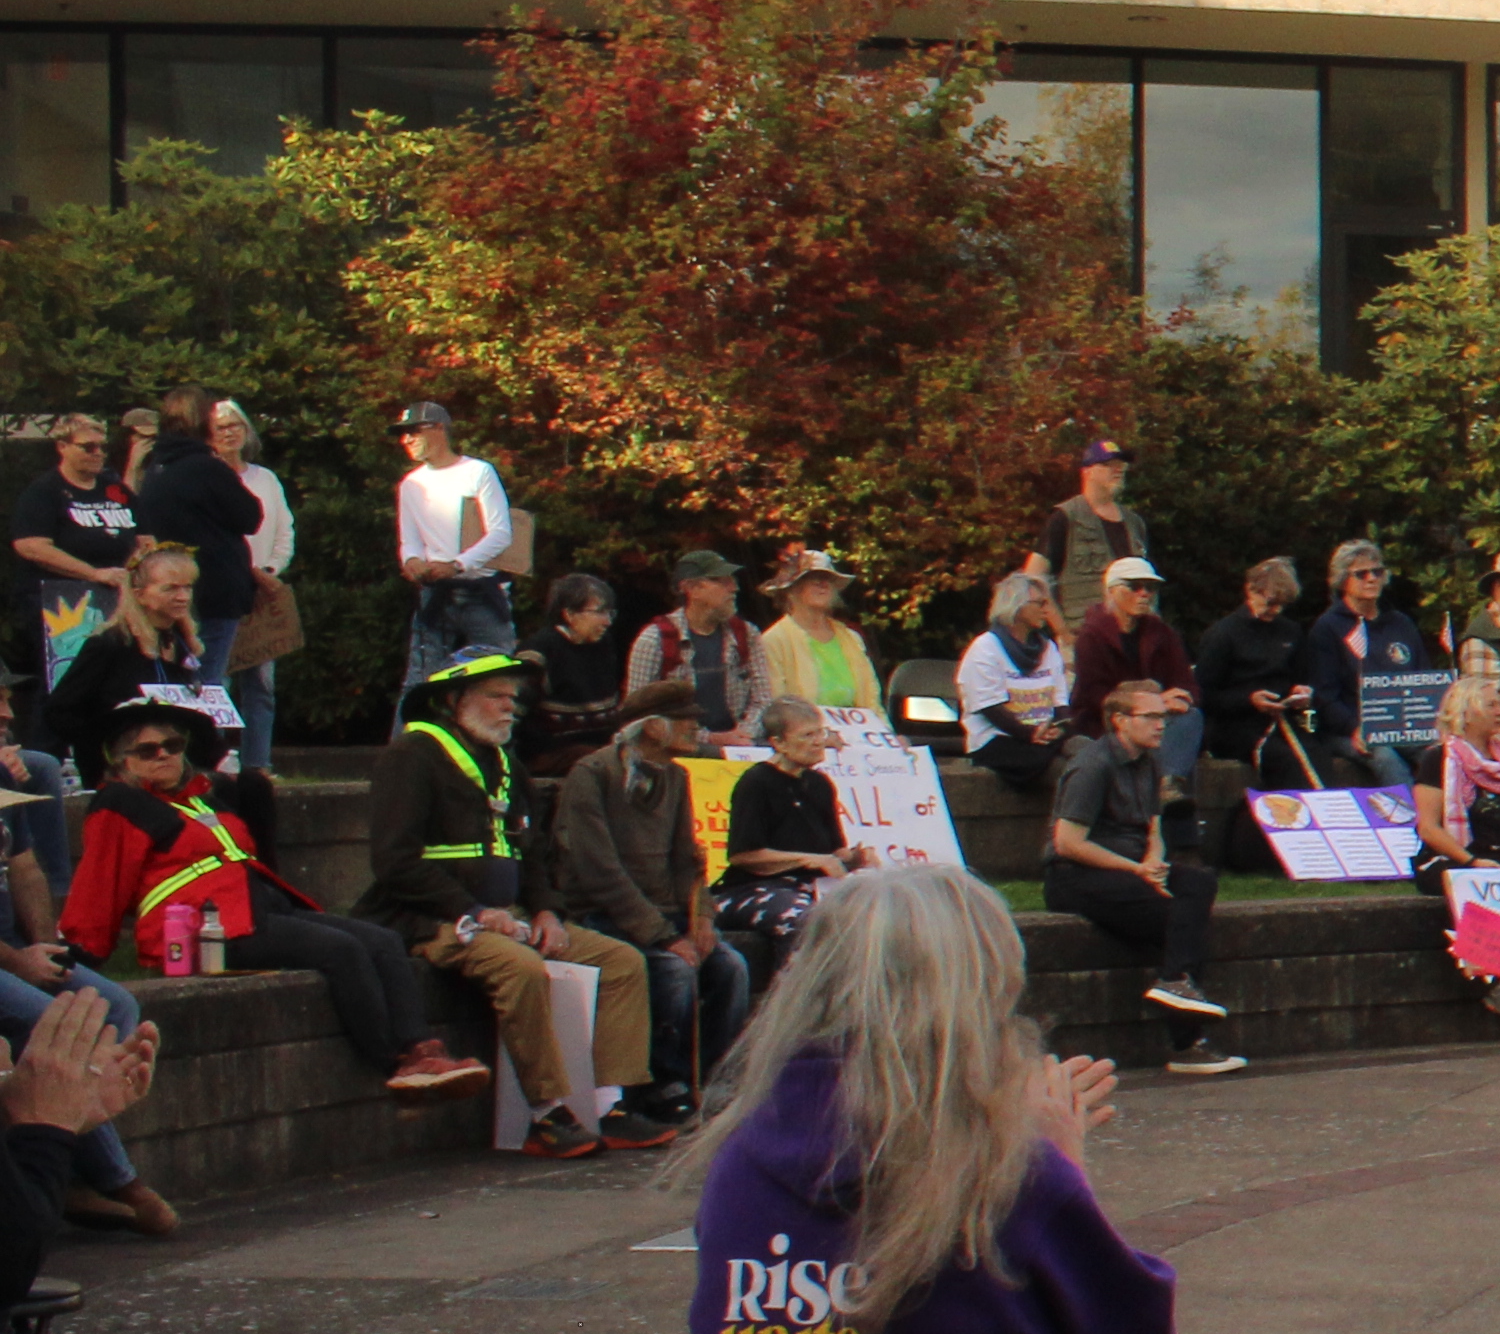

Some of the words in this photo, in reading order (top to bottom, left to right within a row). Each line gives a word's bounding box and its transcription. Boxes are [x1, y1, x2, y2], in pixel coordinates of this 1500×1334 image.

[1363, 673, 1453, 688] PRO-AMERICA
[826, 708, 867, 726] NO
[915, 795, 936, 816] of
[723, 1233, 868, 1325] Rise
